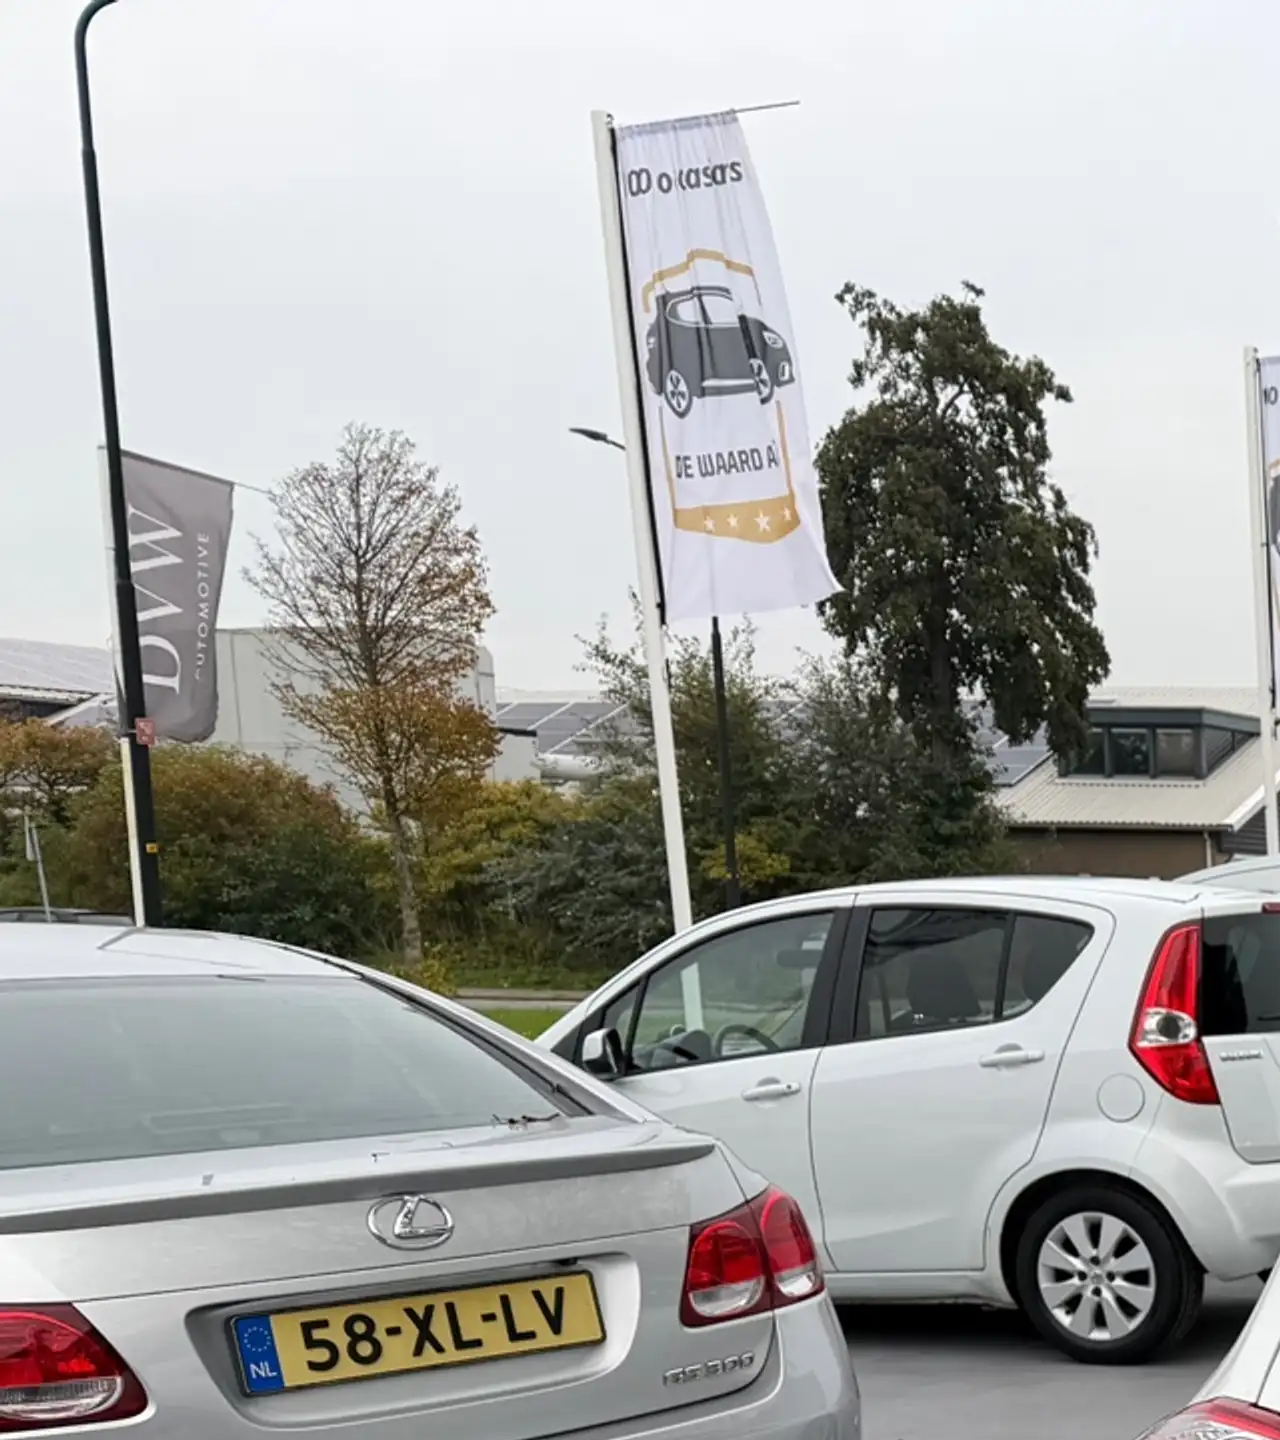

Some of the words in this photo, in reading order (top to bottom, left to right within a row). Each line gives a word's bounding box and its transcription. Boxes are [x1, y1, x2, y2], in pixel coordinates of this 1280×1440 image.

[697, 447, 763, 478] WAARD
[299, 1286, 565, 1372] 58-XL-LV
[250, 1361, 278, 1380] NL
